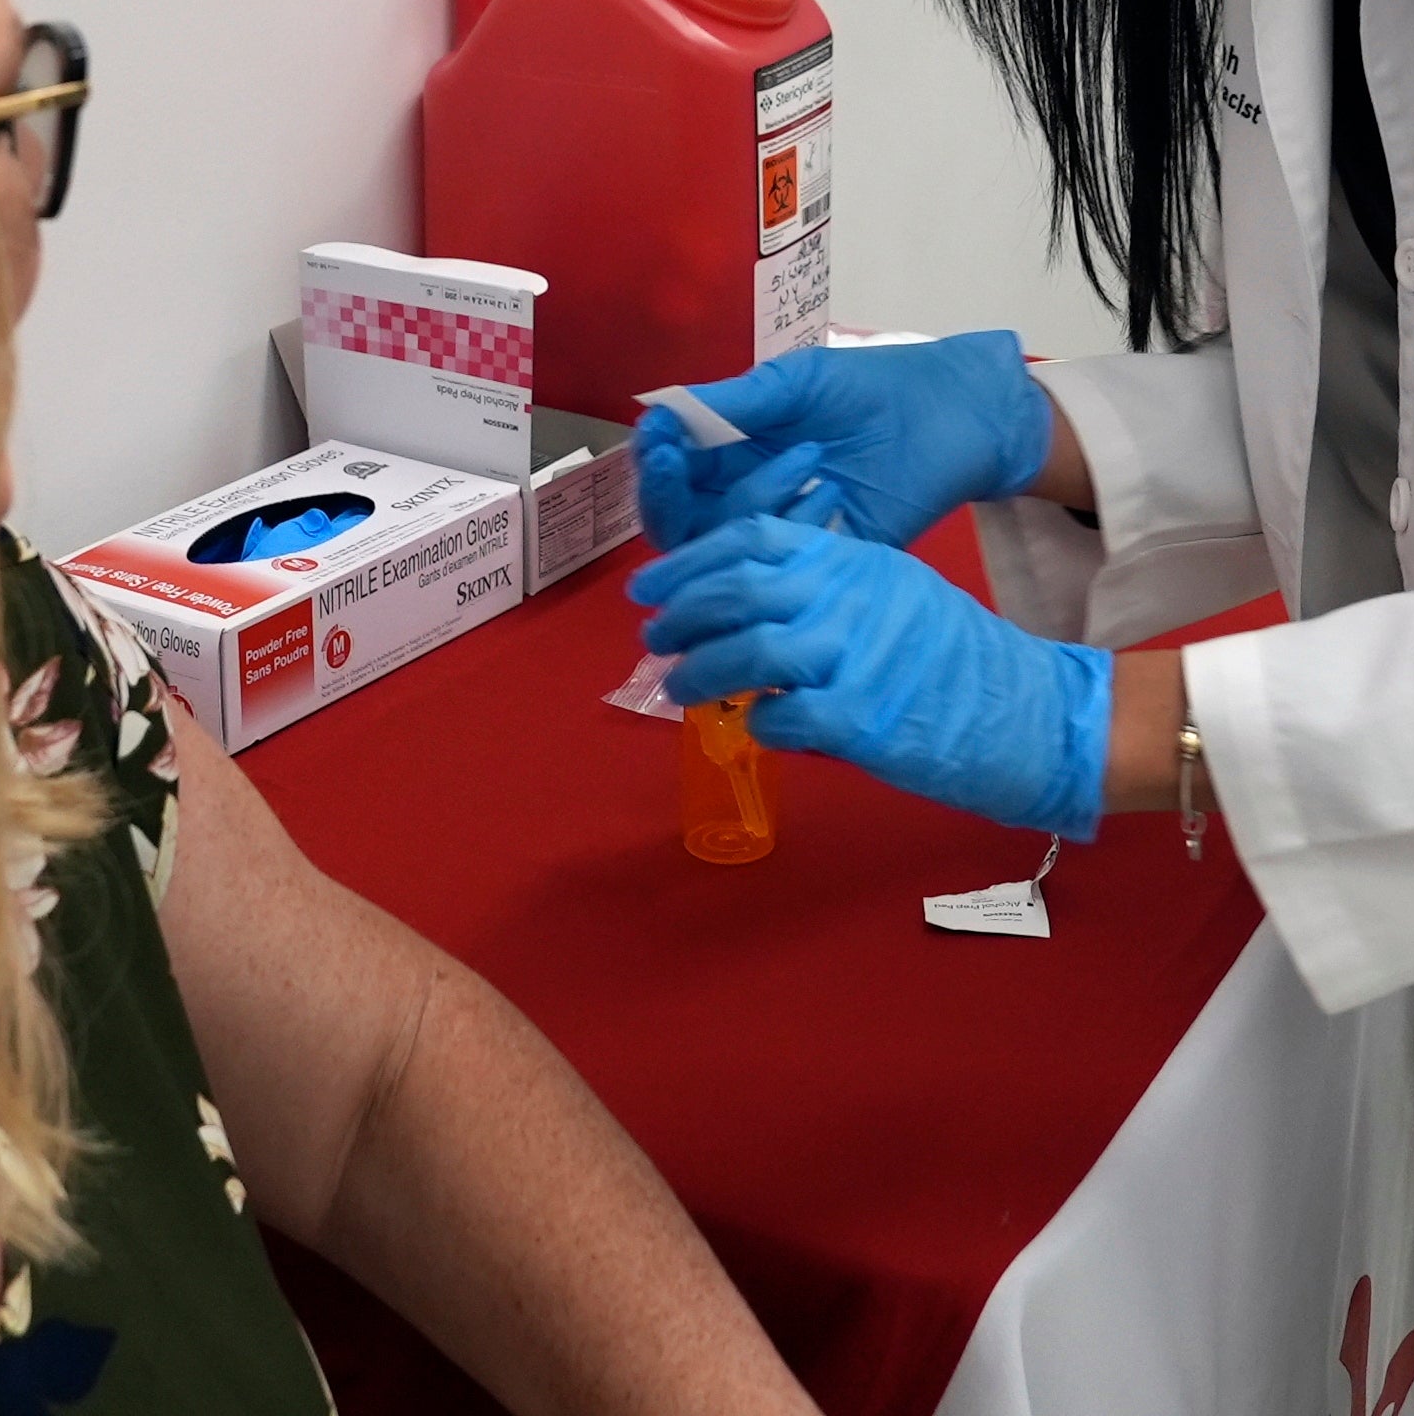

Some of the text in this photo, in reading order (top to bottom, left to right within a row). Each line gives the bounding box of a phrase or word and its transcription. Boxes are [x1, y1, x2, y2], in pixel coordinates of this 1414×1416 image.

[436, 384, 459, 399] Pads
[460, 390, 482, 404] Prep
[483, 395, 519, 412] Alcohol
[131, 500, 209, 538] NITRILE
[203, 466, 295, 508] Examination
[286, 448, 345, 474] Gloves
[318, 566, 380, 619] NITRILE
[382, 533, 463, 587] Examination
[465, 509, 509, 547] Gloves
[417, 569, 441, 589] Gants
[478, 531, 509, 556] NITRILE
[109, 570, 149, 587] Sans
[151, 581, 188, 599] Free
[182, 591, 242, 617] Powder
[160, 627, 201, 658] Gloves
[245, 625, 308, 665] Powder Free
[245, 644, 309, 685] Sans Poudre
